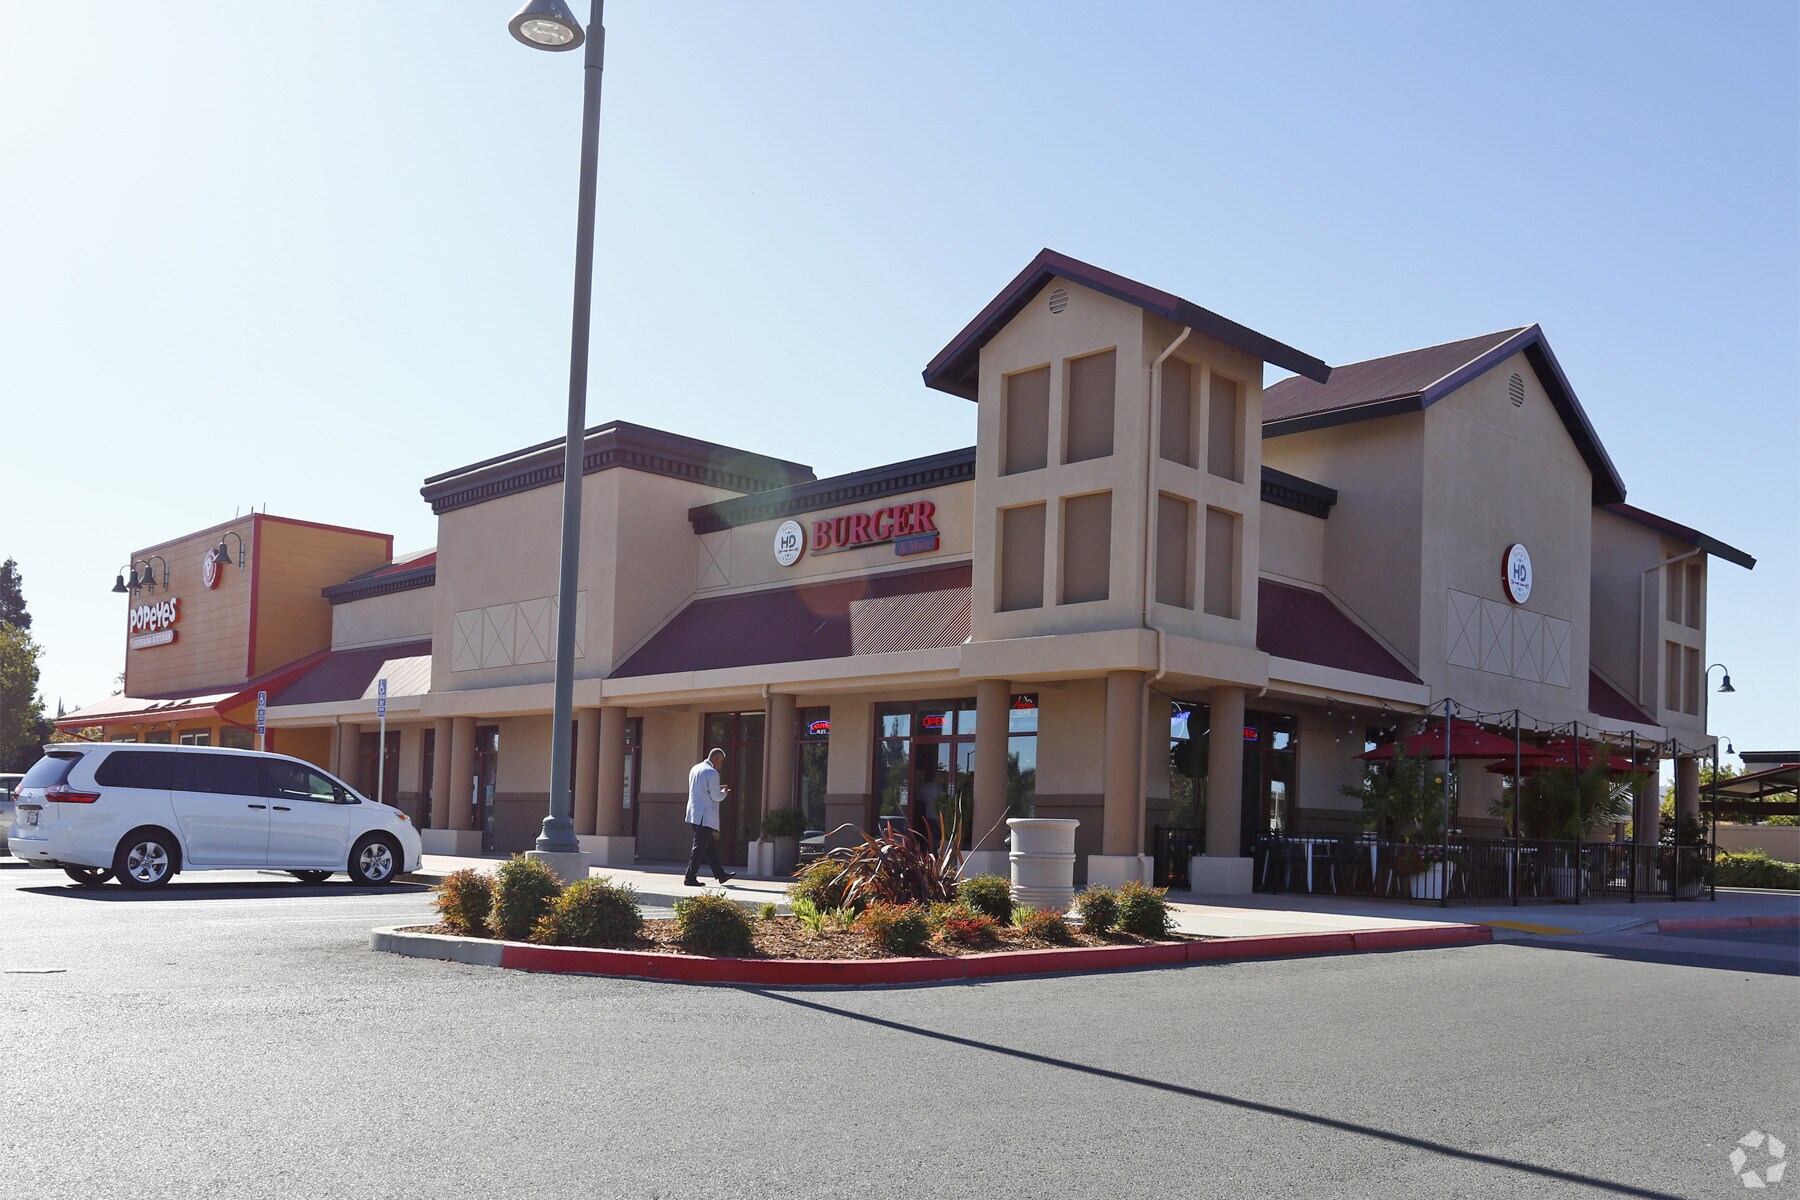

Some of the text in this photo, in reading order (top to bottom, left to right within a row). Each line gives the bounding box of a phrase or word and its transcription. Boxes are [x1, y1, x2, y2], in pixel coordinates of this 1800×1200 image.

[811, 501, 938, 551] BURGER
[781, 535, 796, 550] HD
[1513, 562, 1527, 582] HD
[923, 717, 948, 727] OPEN
